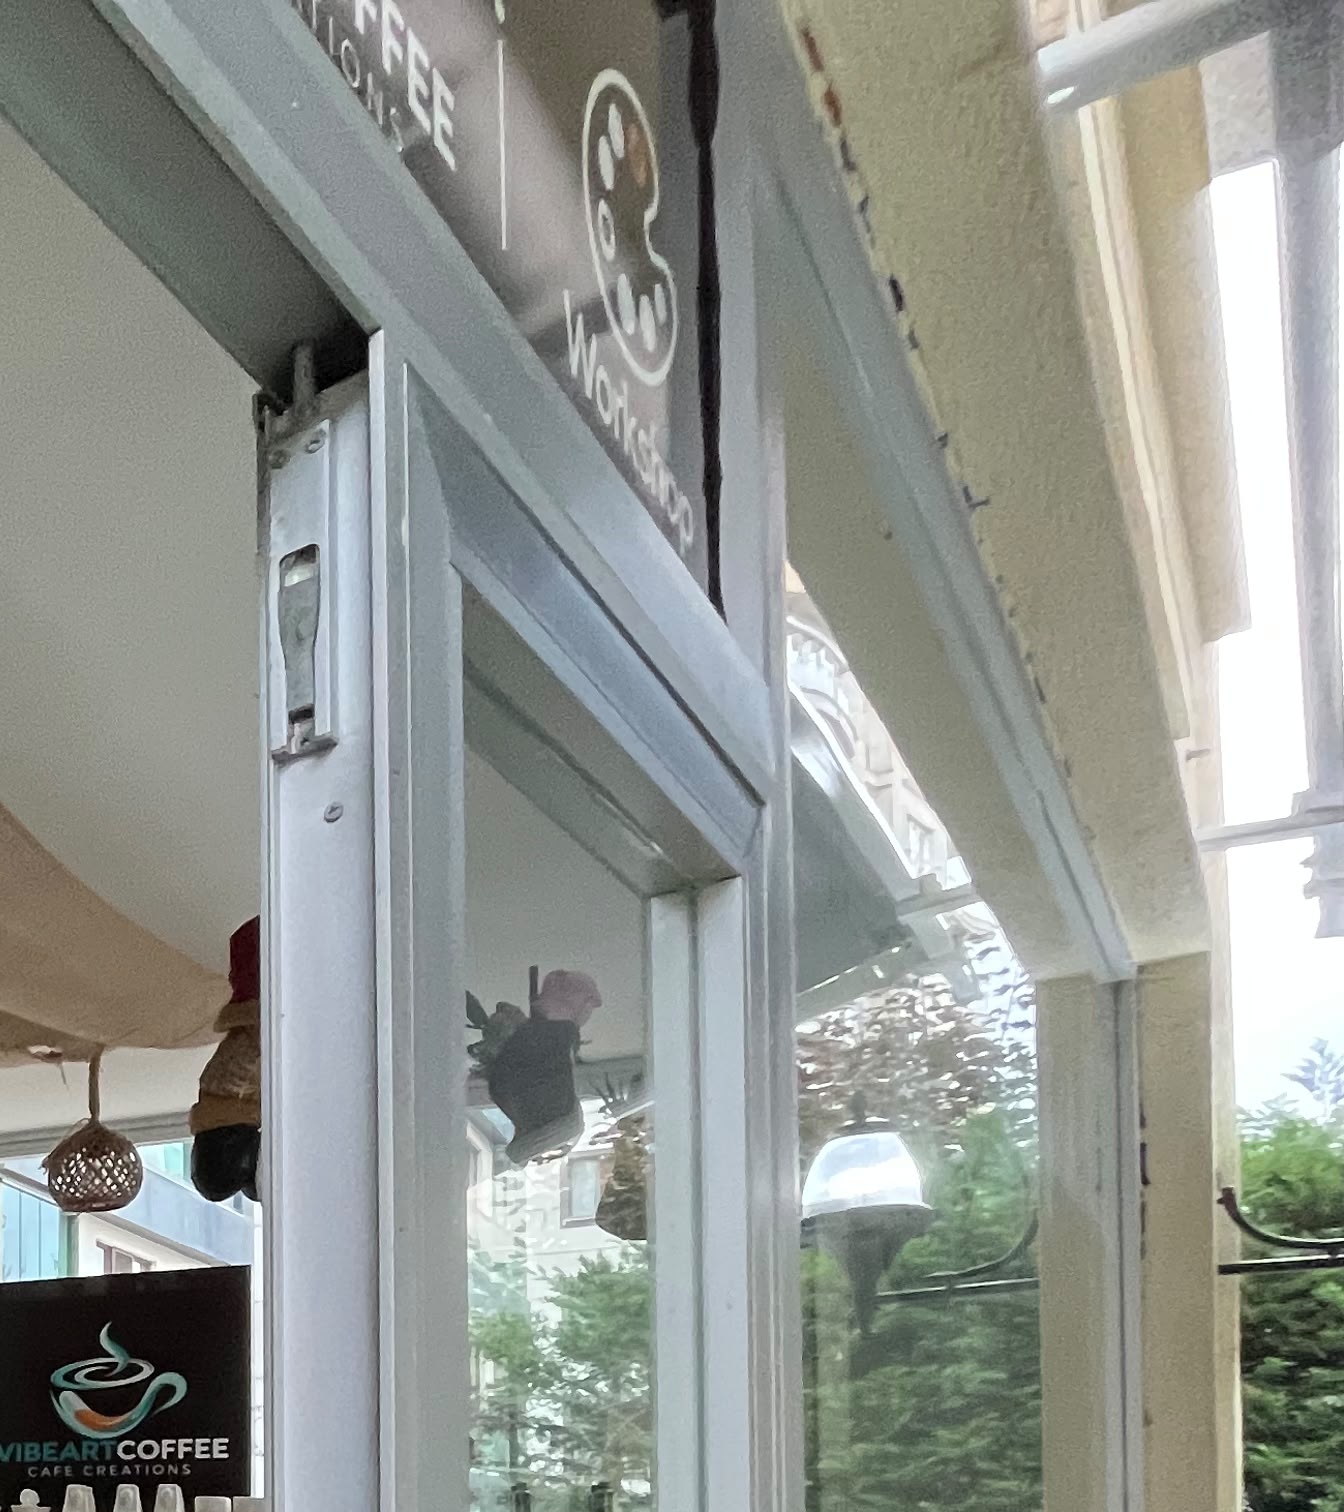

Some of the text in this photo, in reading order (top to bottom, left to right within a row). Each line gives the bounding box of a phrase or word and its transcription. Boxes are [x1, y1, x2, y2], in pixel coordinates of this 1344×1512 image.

[563, 289, 694, 557] Workshop
[27, 1464, 192, 1477] CAFE CREATIONS
